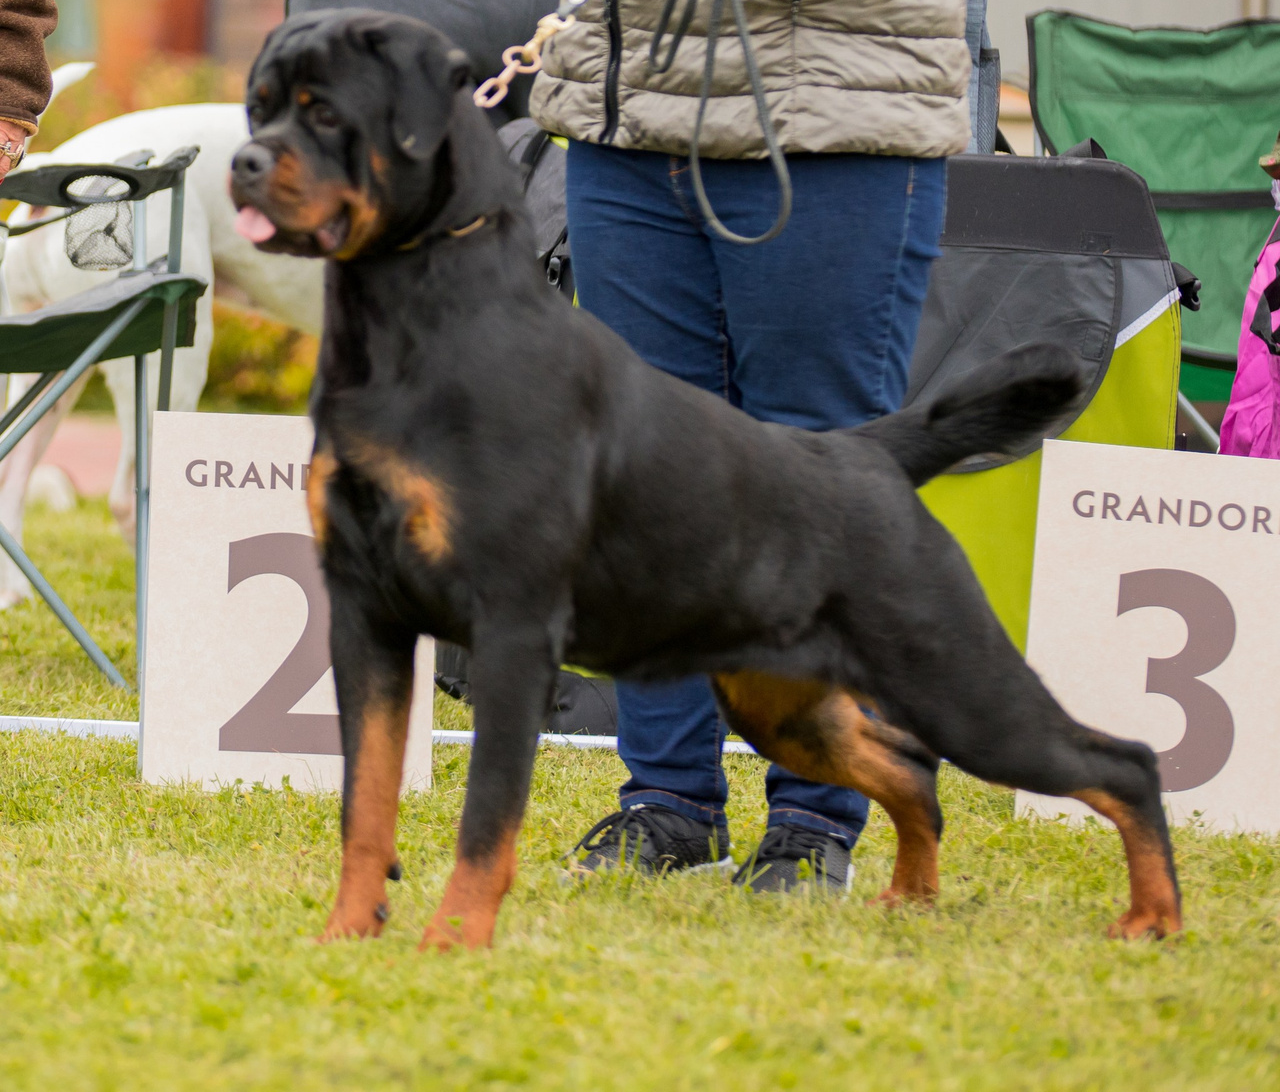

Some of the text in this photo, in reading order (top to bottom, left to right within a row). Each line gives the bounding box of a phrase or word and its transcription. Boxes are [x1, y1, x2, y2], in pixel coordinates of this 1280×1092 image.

[1072, 490, 1280, 535] GRANDOR
[219, 532, 344, 756] 2
[1116, 568, 1236, 792] 3
